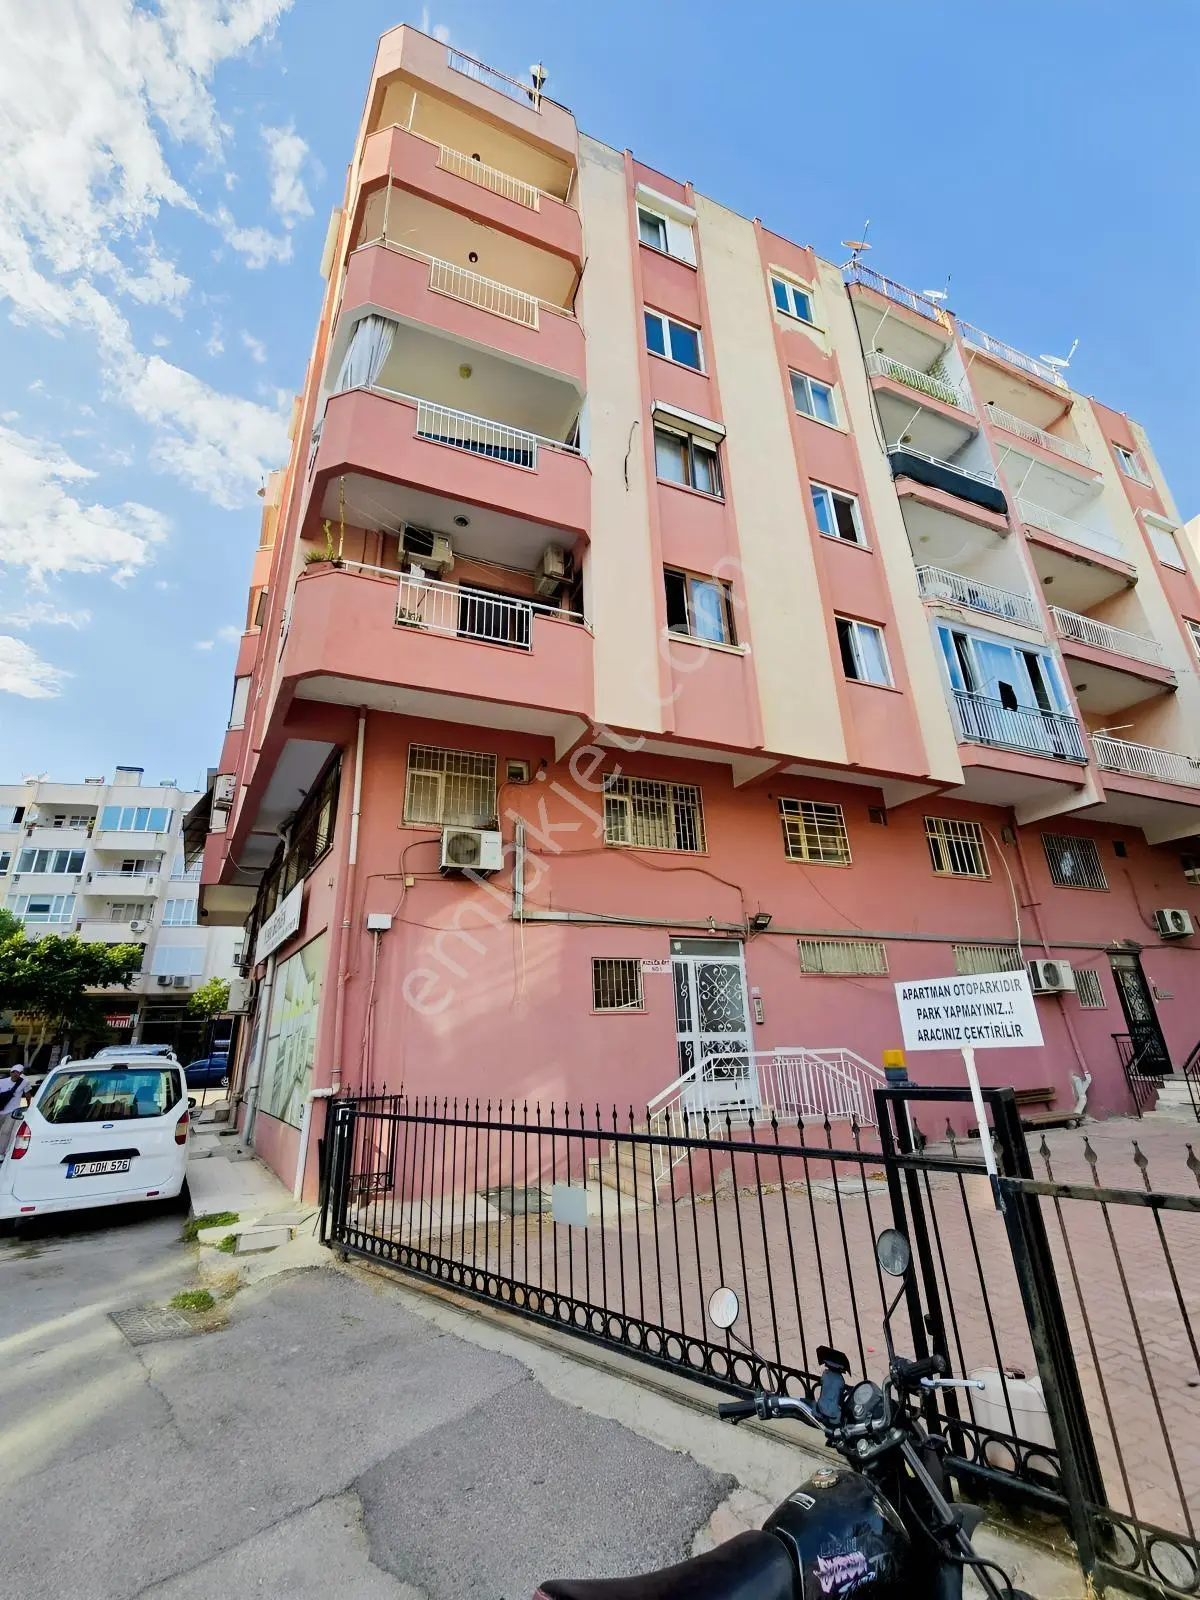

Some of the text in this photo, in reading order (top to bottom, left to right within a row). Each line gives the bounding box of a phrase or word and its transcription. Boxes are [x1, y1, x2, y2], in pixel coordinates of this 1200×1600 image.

[902, 978, 1022, 1001] APARTMAN OTOPARKIDIR
[917, 1006, 942, 1020] PARK
[918, 1021, 1024, 1043] ARACINIZ ÇEKTİRİLİR
[74, 1164, 86, 1175] 07
[110, 1160, 128, 1171] 576
